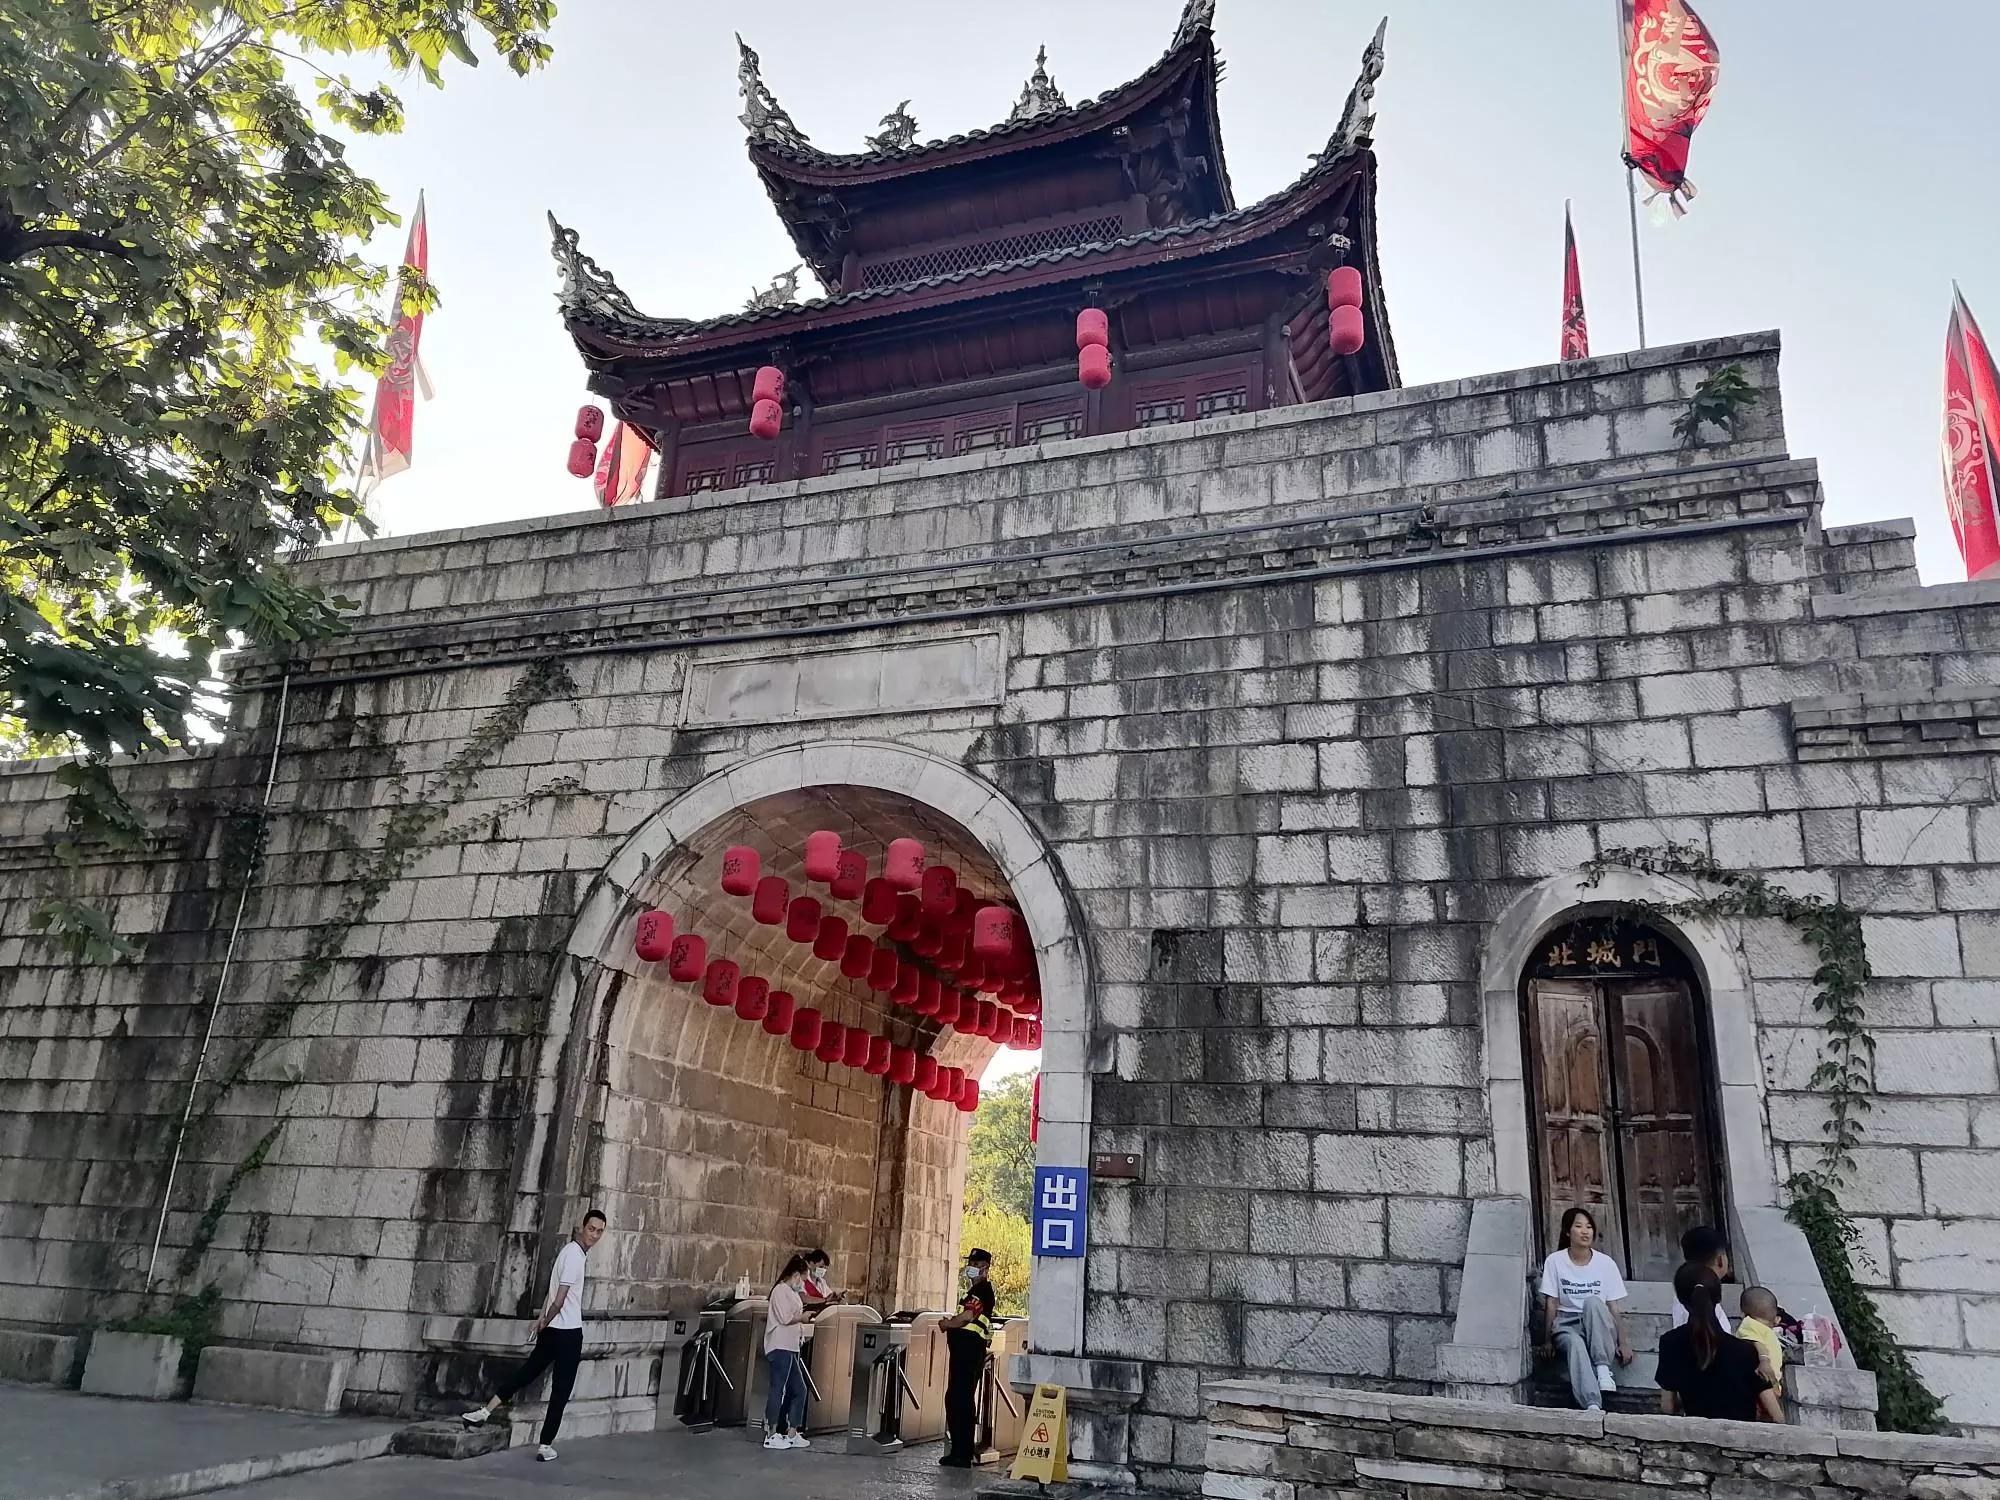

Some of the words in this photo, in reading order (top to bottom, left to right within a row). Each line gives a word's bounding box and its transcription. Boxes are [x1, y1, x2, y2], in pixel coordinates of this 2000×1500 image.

[1042, 1174, 1077, 1250] 出口
[1023, 1445, 1050, 1458] 小心地滑
